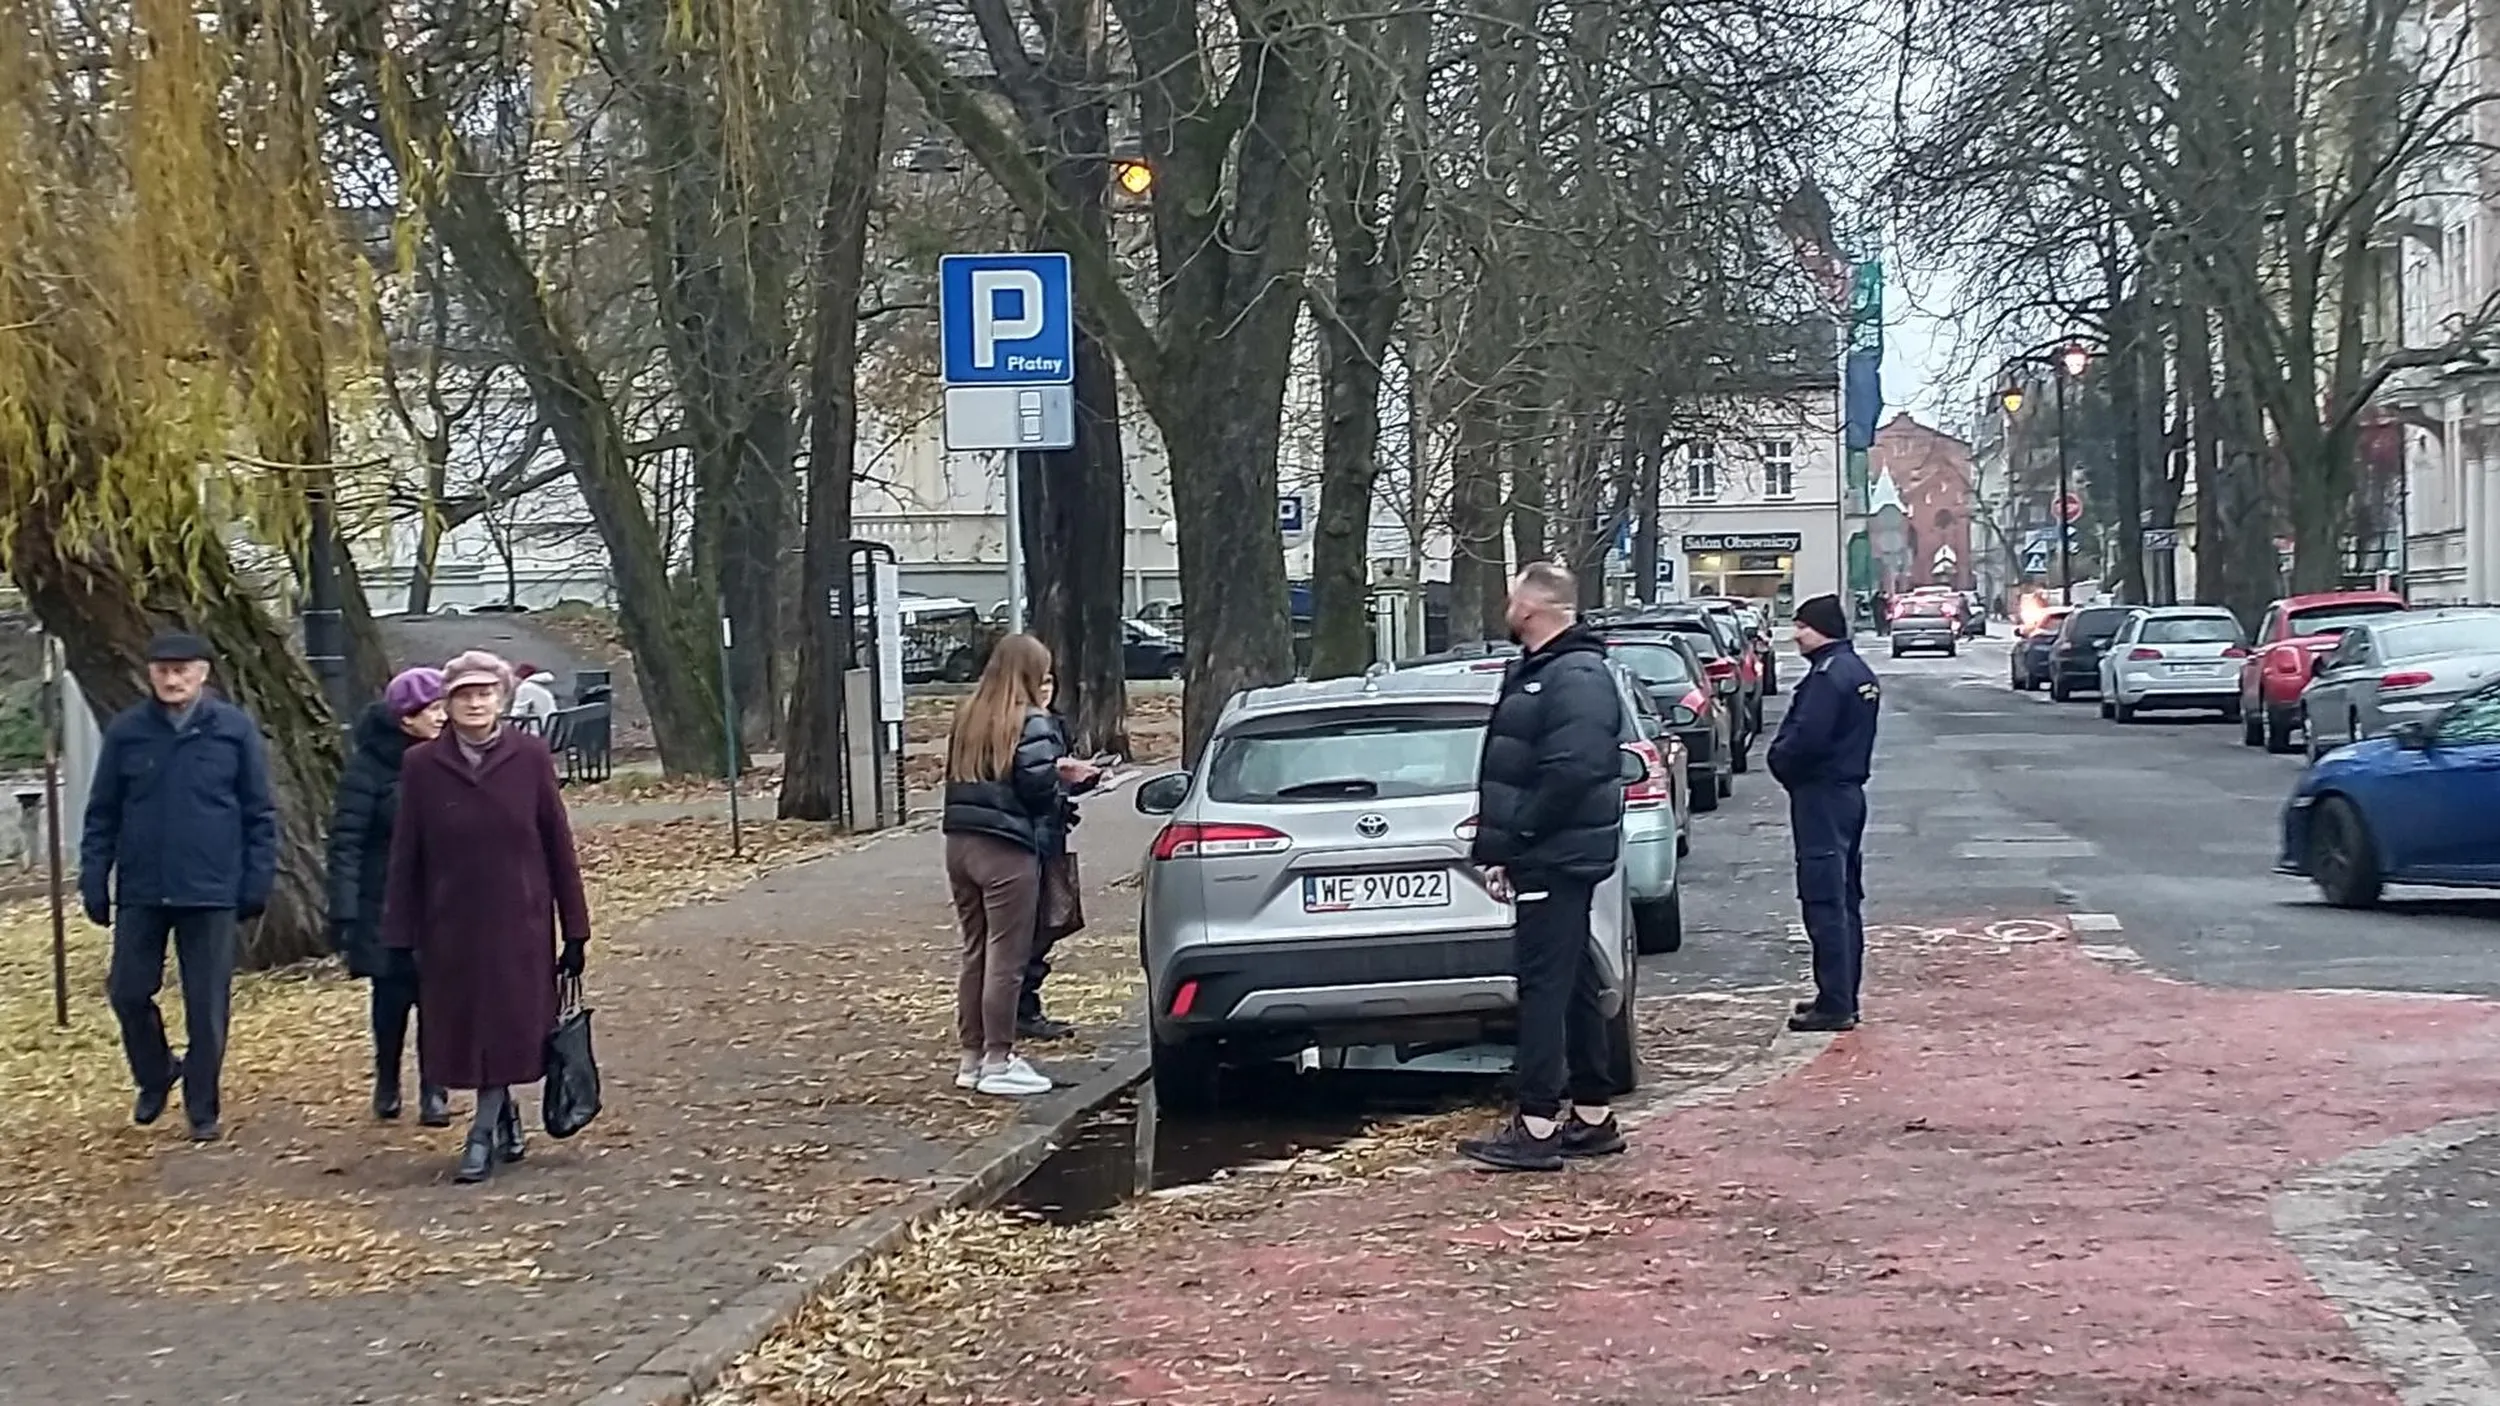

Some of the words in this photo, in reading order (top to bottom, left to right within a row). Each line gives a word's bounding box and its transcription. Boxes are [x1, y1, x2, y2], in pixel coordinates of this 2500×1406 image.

[972, 269, 1044, 368] P
[1684, 536, 1722, 549] Salon
[1656, 562, 1670, 579] P
[1322, 878, 1355, 902] WE
[1363, 874, 1442, 900] 9V022
